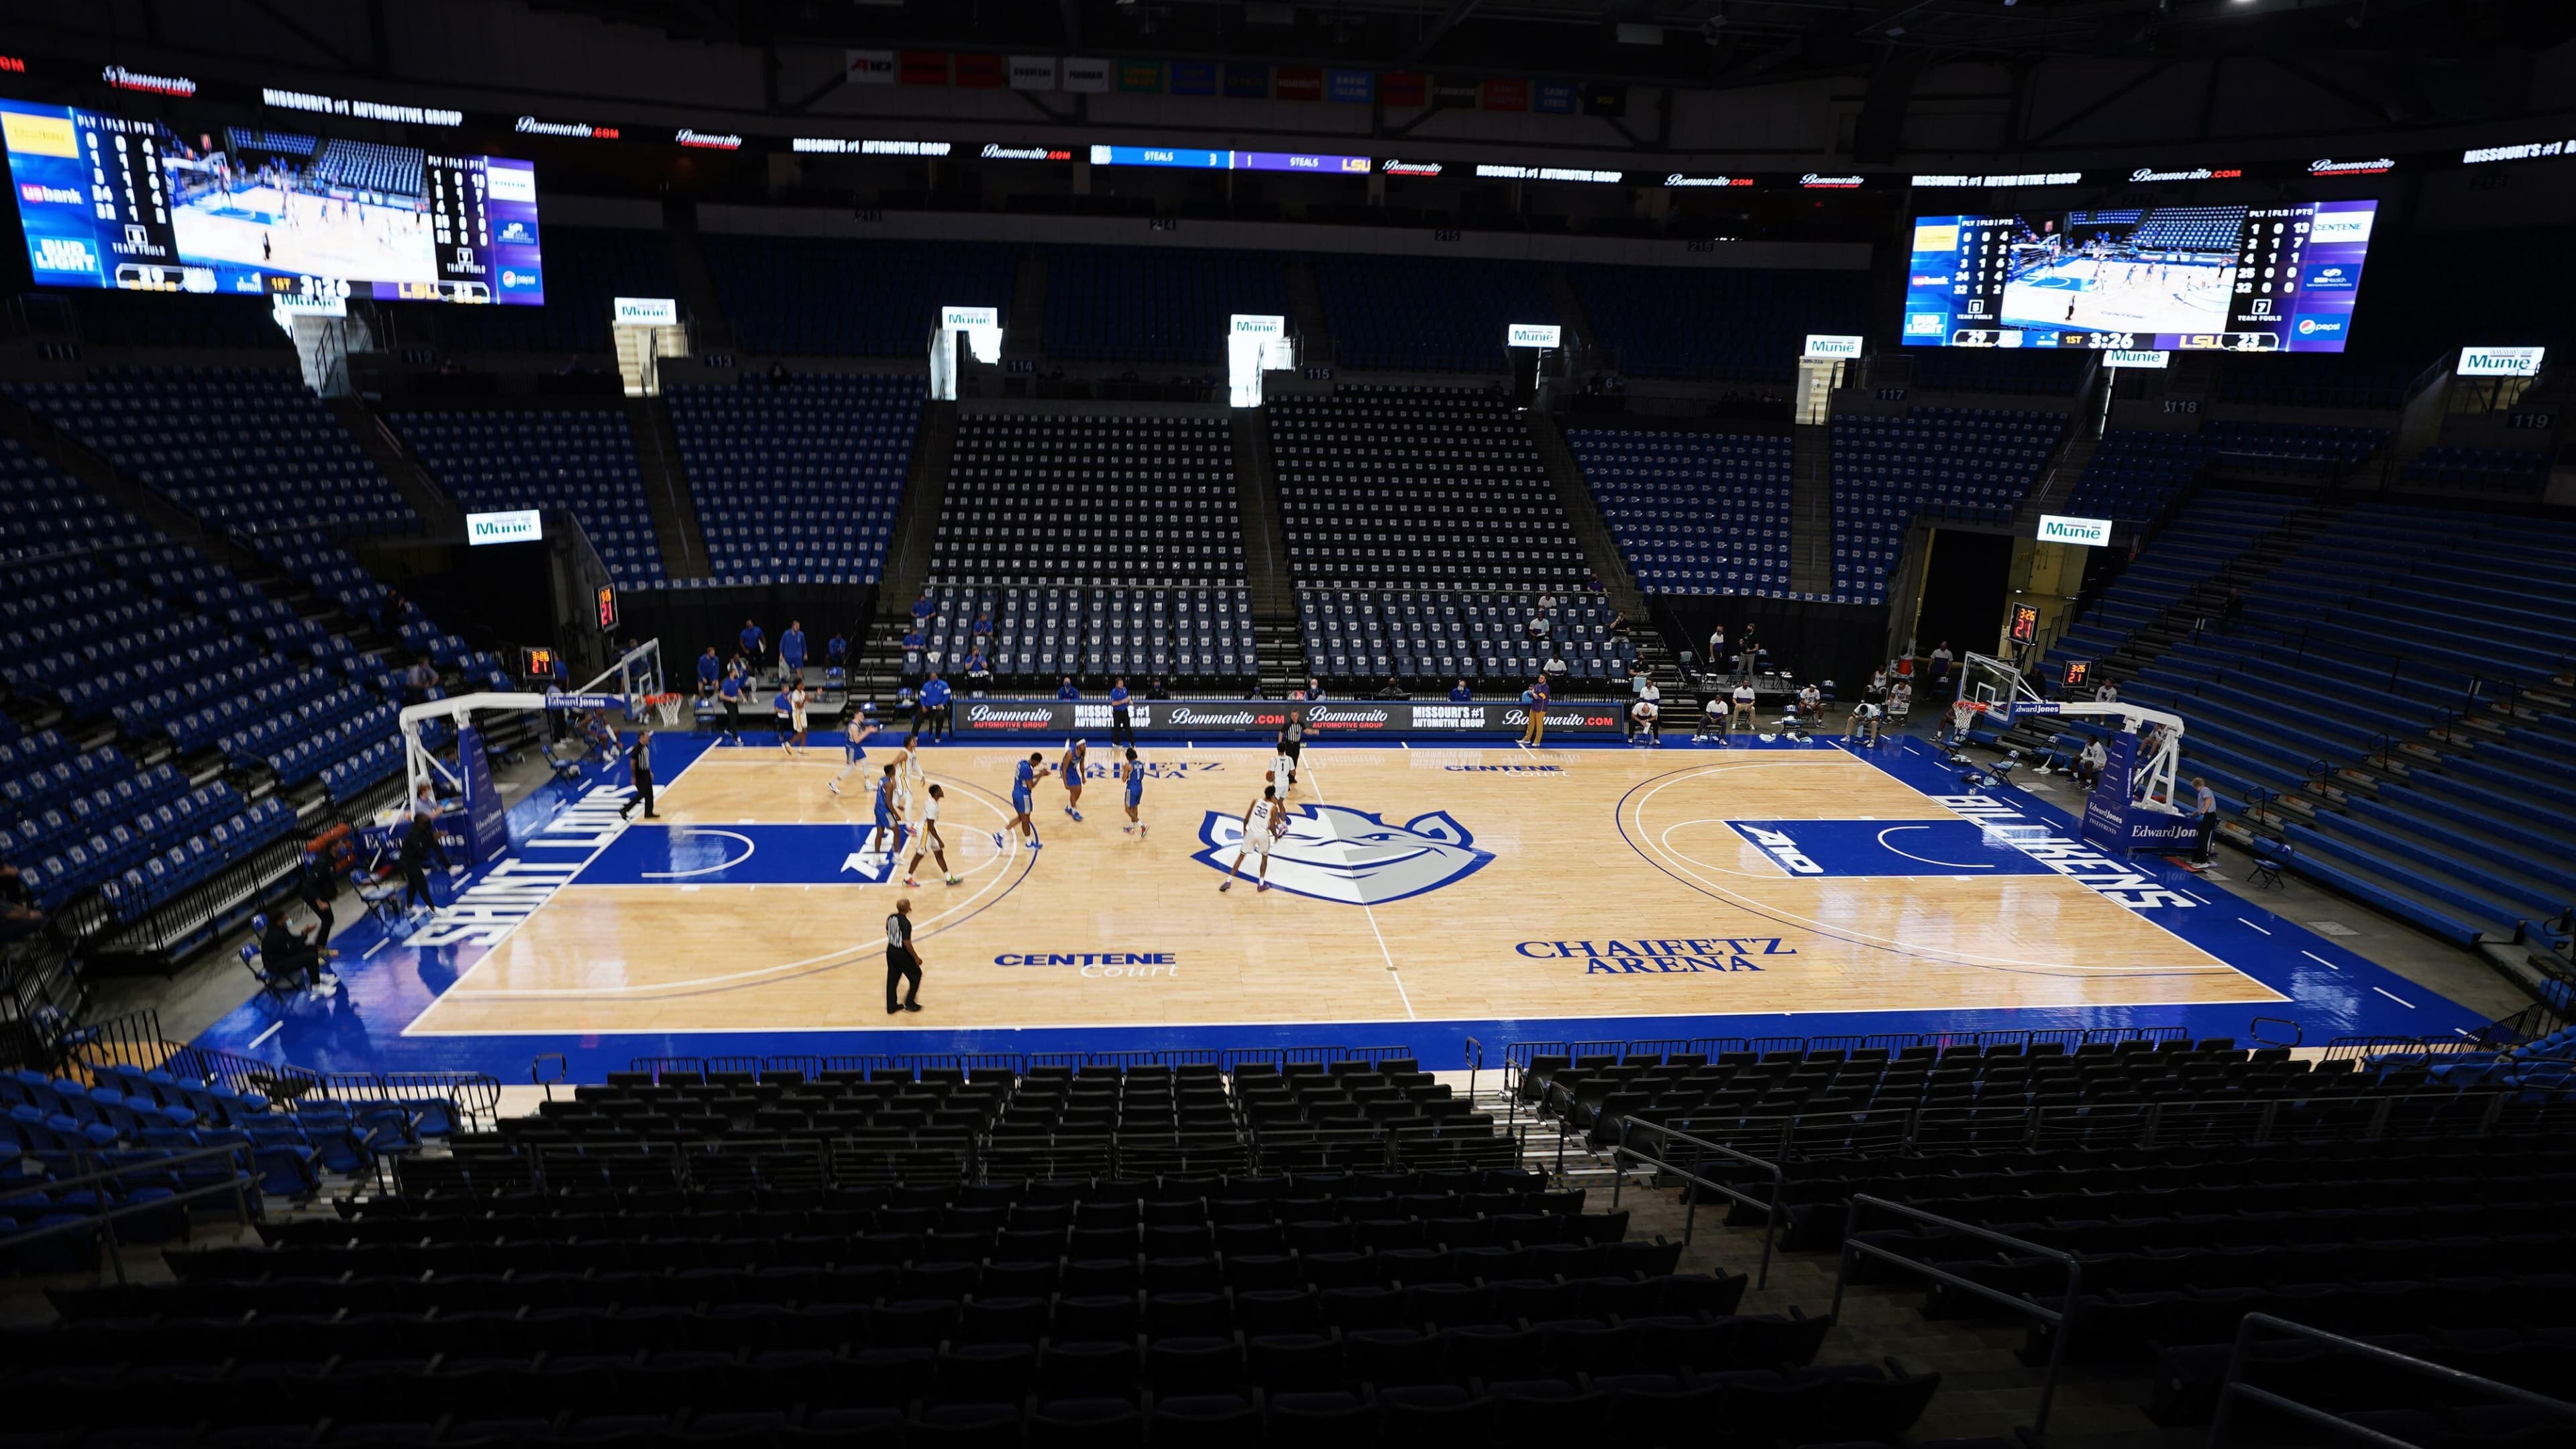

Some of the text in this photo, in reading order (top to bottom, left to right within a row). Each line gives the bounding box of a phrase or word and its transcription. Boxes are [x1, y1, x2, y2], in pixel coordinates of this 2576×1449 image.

[263, 88, 463, 127] MISSOURI'S #1 AUTOMOTIVE GROUP
[793, 138, 951, 156] MISSOURI'S #1 AUTOMOTIVE GROUP
[2463, 141, 2563, 164] MISSOURI'S #1
[1144, 151, 1217, 165] STEALS 3
[1289, 157, 1319, 167] STEALS
[1342, 158, 1371, 172] LSU
[2308, 158, 2396, 172] Bommarito
[1477, 165, 1622, 183] MISSOURI'S #1 AUTOMOTIVE GROUP
[1799, 173, 1864, 185] Bommarito
[1911, 172, 2082, 186] MISSOURI'S #1 AUTOMOTIVE GROUP
[2251, 222, 2310, 235] 1 0 13
[2314, 223, 2363, 231] CENTENE
[1963, 232, 1972, 242] 0
[1982, 231, 1990, 241] 0
[1999, 231, 2008, 241] 4
[2247, 237, 2304, 249] 2 1 7
[1962, 244, 2006, 255] 1 1 2
[35, 251, 95, 272] LIGHT
[1960, 258, 2004, 268] 3 1 6
[2244, 252, 2300, 264] 4 1 1
[1955, 271, 2003, 281] 24 1 4
[2238, 267, 2297, 278] 25 0 0
[271, 277, 291, 291] 1ST
[300, 274, 351, 298] 3:26
[398, 282, 439, 299] LSU
[1953, 284, 2001, 294] 32 1 2
[2235, 282, 2253, 293] 32
[2261, 282, 2271, 293] 0
[2284, 282, 2294, 293] 0
[623, 306, 668, 317] Munie
[2257, 303, 2267, 313] 7
[949, 314, 990, 324] Munie
[1236, 321, 1277, 333] Munie
[2315, 322, 2341, 331] pepsi
[1514, 330, 1553, 342] Munie
[1968, 331, 1987, 344] 29
[2065, 335, 2083, 344] 1ST
[2088, 332, 2134, 350] 3:26
[2179, 333, 2222, 349] LSU
[2237, 334, 2260, 347] 23
[1812, 341, 1854, 353] Munie
[2111, 350, 2161, 363] Munie
[2467, 355, 2530, 370] Munie
[1011, 360, 1033, 372] 114
[1307, 368, 1330, 380] 115
[1880, 389, 1904, 400] 117
[2513, 413, 2548, 428] 119
[476, 522, 532, 535] Munie
[2046, 522, 2100, 539] Munie
[2020, 608, 2035, 621] 3:26
[2014, 619, 2031, 638] 21
[2072, 664, 2086, 673] 3:26
[2068, 673, 2082, 683] 21
[967, 704, 1052, 722] Bommarito
[1136, 705, 1150, 716] #1
[1306, 706, 1387, 722] Bommarito
[1412, 706, 1484, 718] MISSOURI'S #1
[1412, 718, 1485, 728] AUTOMOTIVE GROUP
[1737, 823, 1825, 873] A10
[1929, 795, 2197, 908] BILLIKENS
[1515, 937, 1798, 959] CHAIFETZ
[994, 953, 1176, 967] CENTENE
[1585, 955, 1766, 974] ARENA
[1080, 963, 1179, 978] Court
